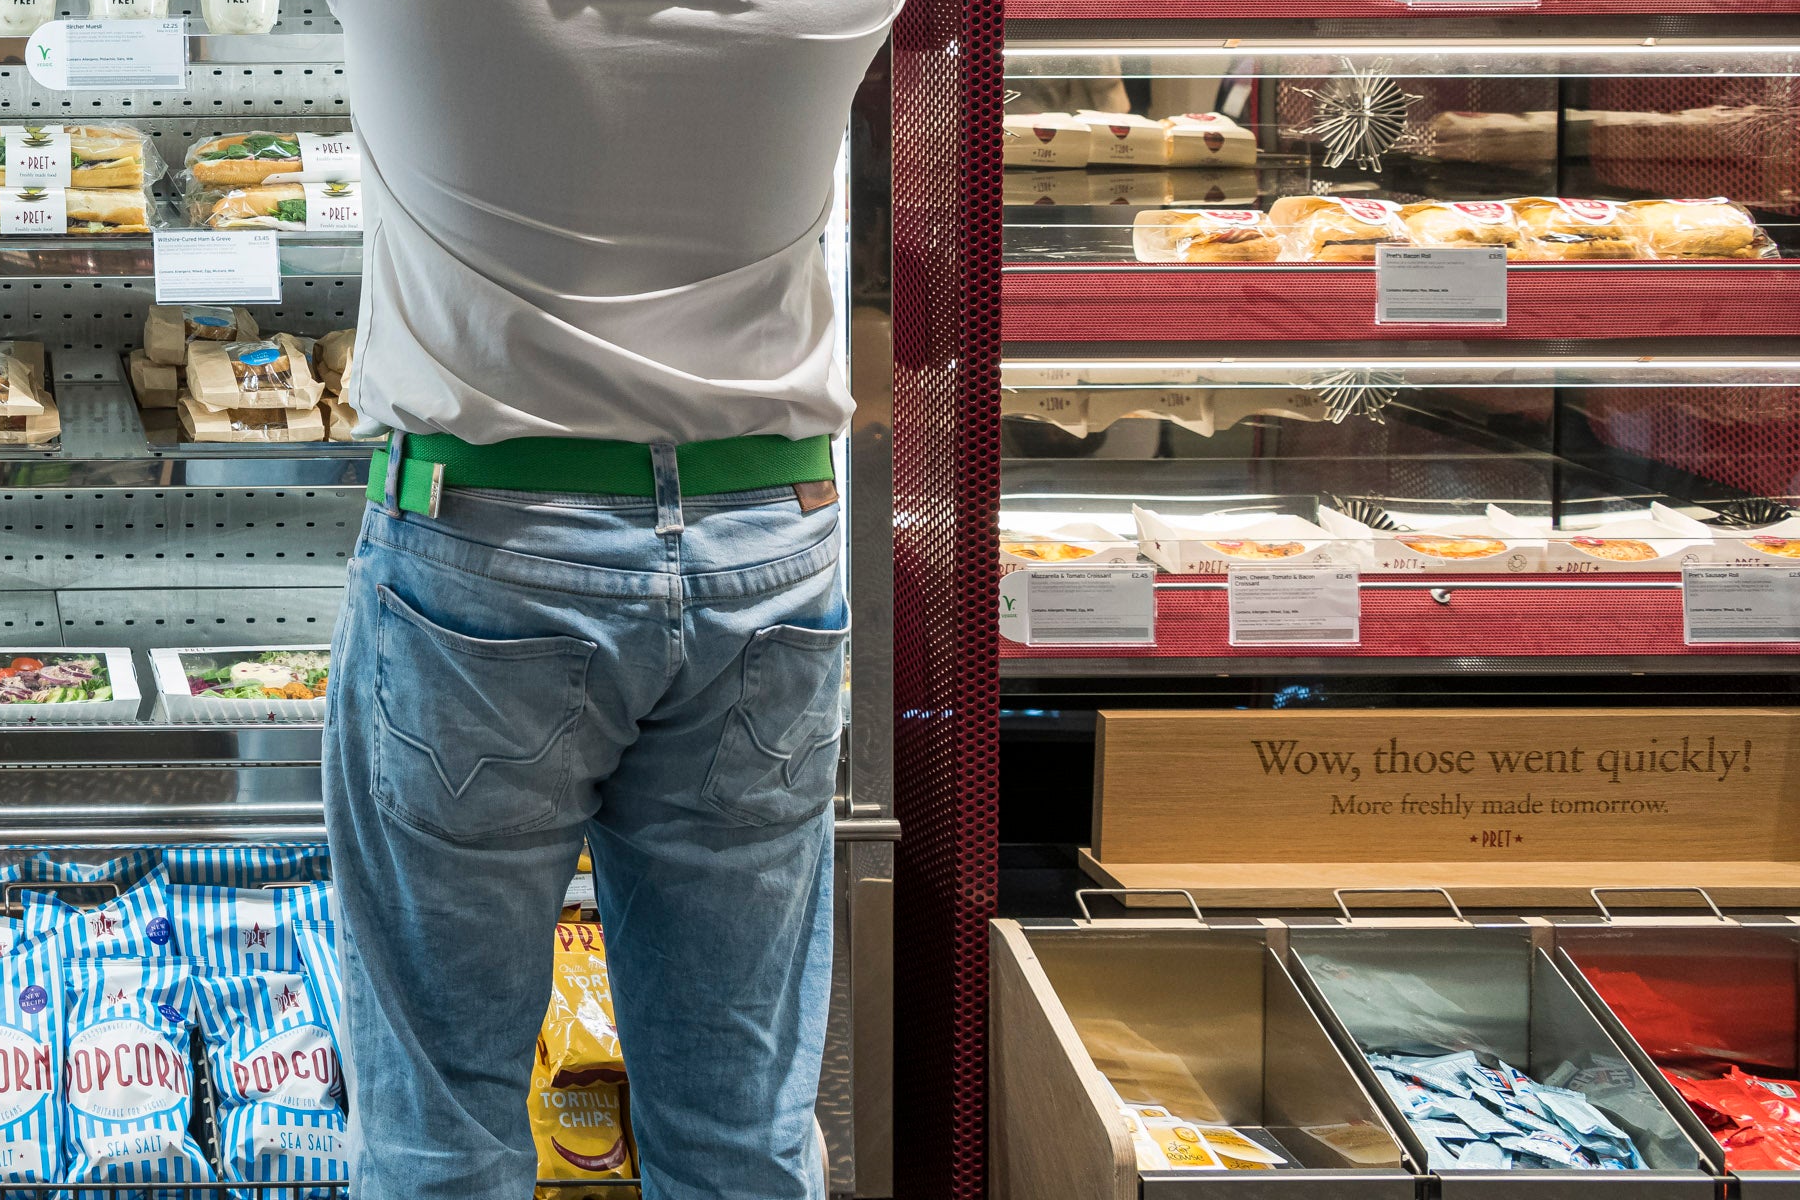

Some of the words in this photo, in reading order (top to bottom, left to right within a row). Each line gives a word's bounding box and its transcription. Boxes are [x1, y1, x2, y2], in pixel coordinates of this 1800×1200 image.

[28, 156, 50, 170] PRET
[1198, 560, 1222, 574] PRET
[1251, 739, 1361, 780] Wow,
[1373, 737, 1476, 776] those
[1488, 744, 1586, 775] went
[1596, 736, 1753, 783] quickly!
[1331, 794, 1393, 816] More
[1400, 792, 1474, 819] freshly
[1481, 792, 1545, 816] made
[1550, 794, 1670, 816] tomorrow.
[1481, 830, 1512, 848] PRET
[244, 929, 270, 945] PRET
[21, 997, 47, 1007] RECIPE
[25, 991, 41, 999] NEW
[558, 1112, 614, 1128] CHIPS
[107, 1138, 130, 1158] SEA
[137, 1134, 162, 1154] SALT
[280, 1131, 302, 1150] SEA
[308, 1134, 334, 1153] SALT
[1165, 1151, 1205, 1162] ROWSE
